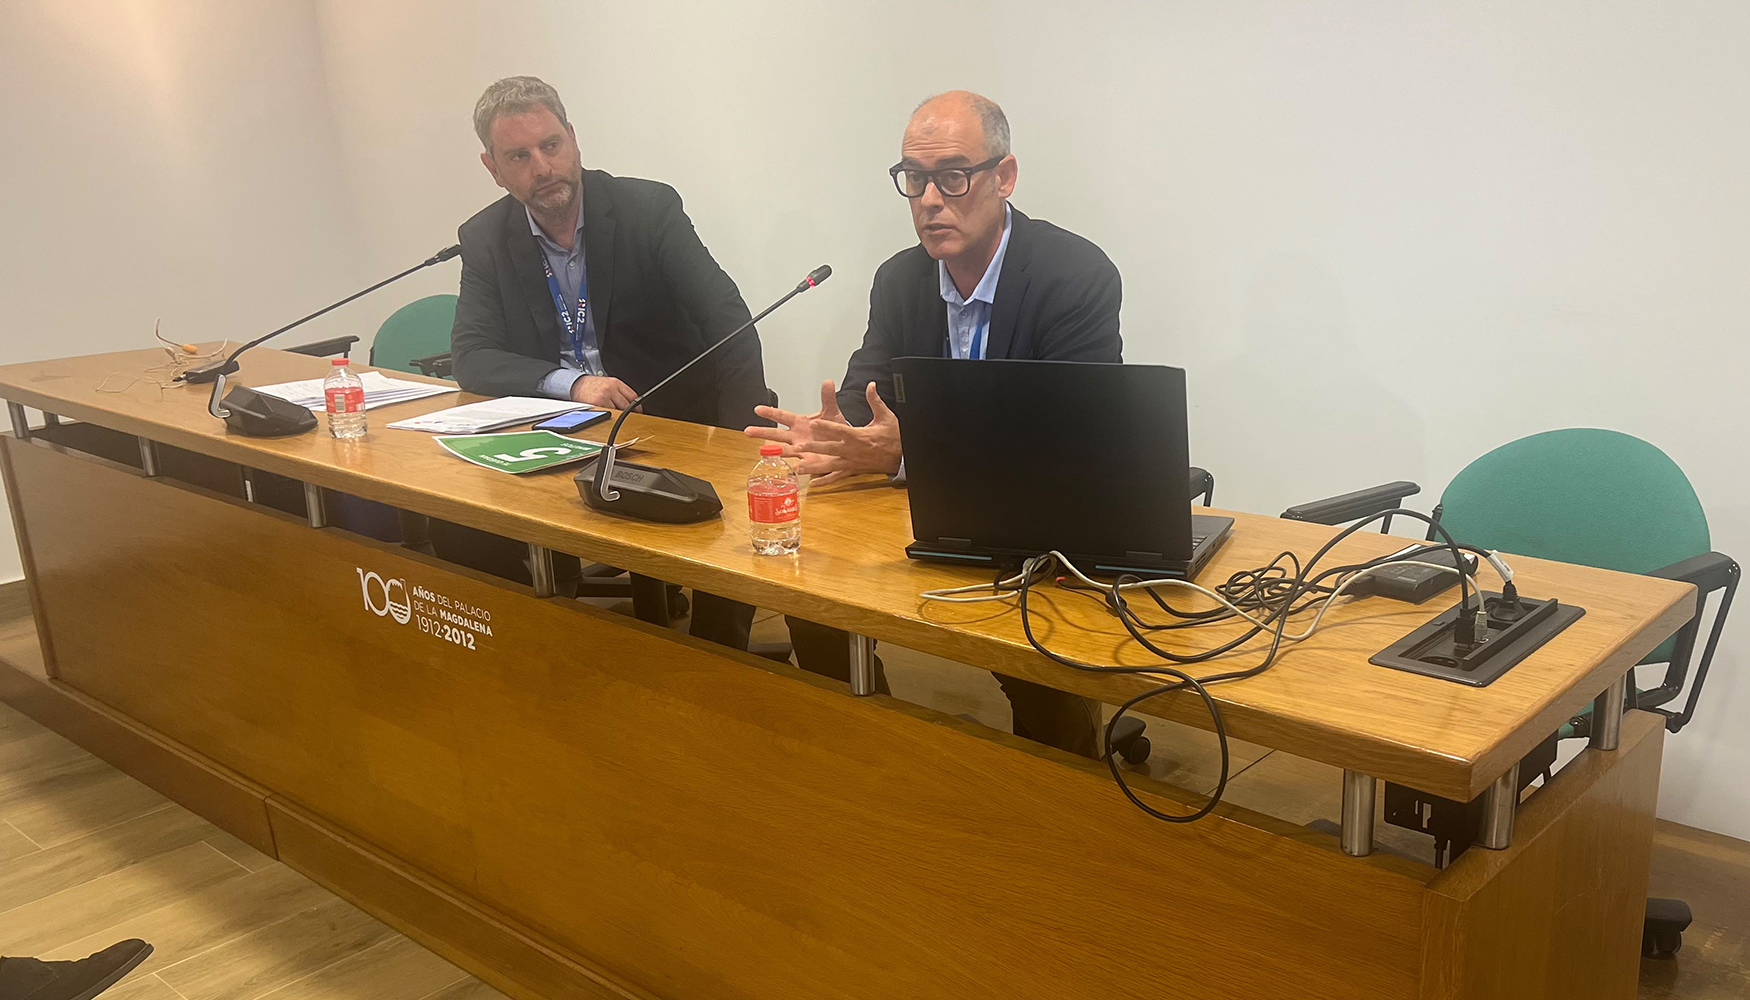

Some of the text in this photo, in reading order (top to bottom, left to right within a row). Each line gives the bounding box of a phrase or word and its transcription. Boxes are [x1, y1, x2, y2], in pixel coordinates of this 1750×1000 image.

[493, 447, 572, 463] 5
[615, 470, 645, 482] BOSCH
[412, 585, 492, 622] AÑOS DEL PALACIO
[413, 600, 493, 637] DE LA MAGDALENA
